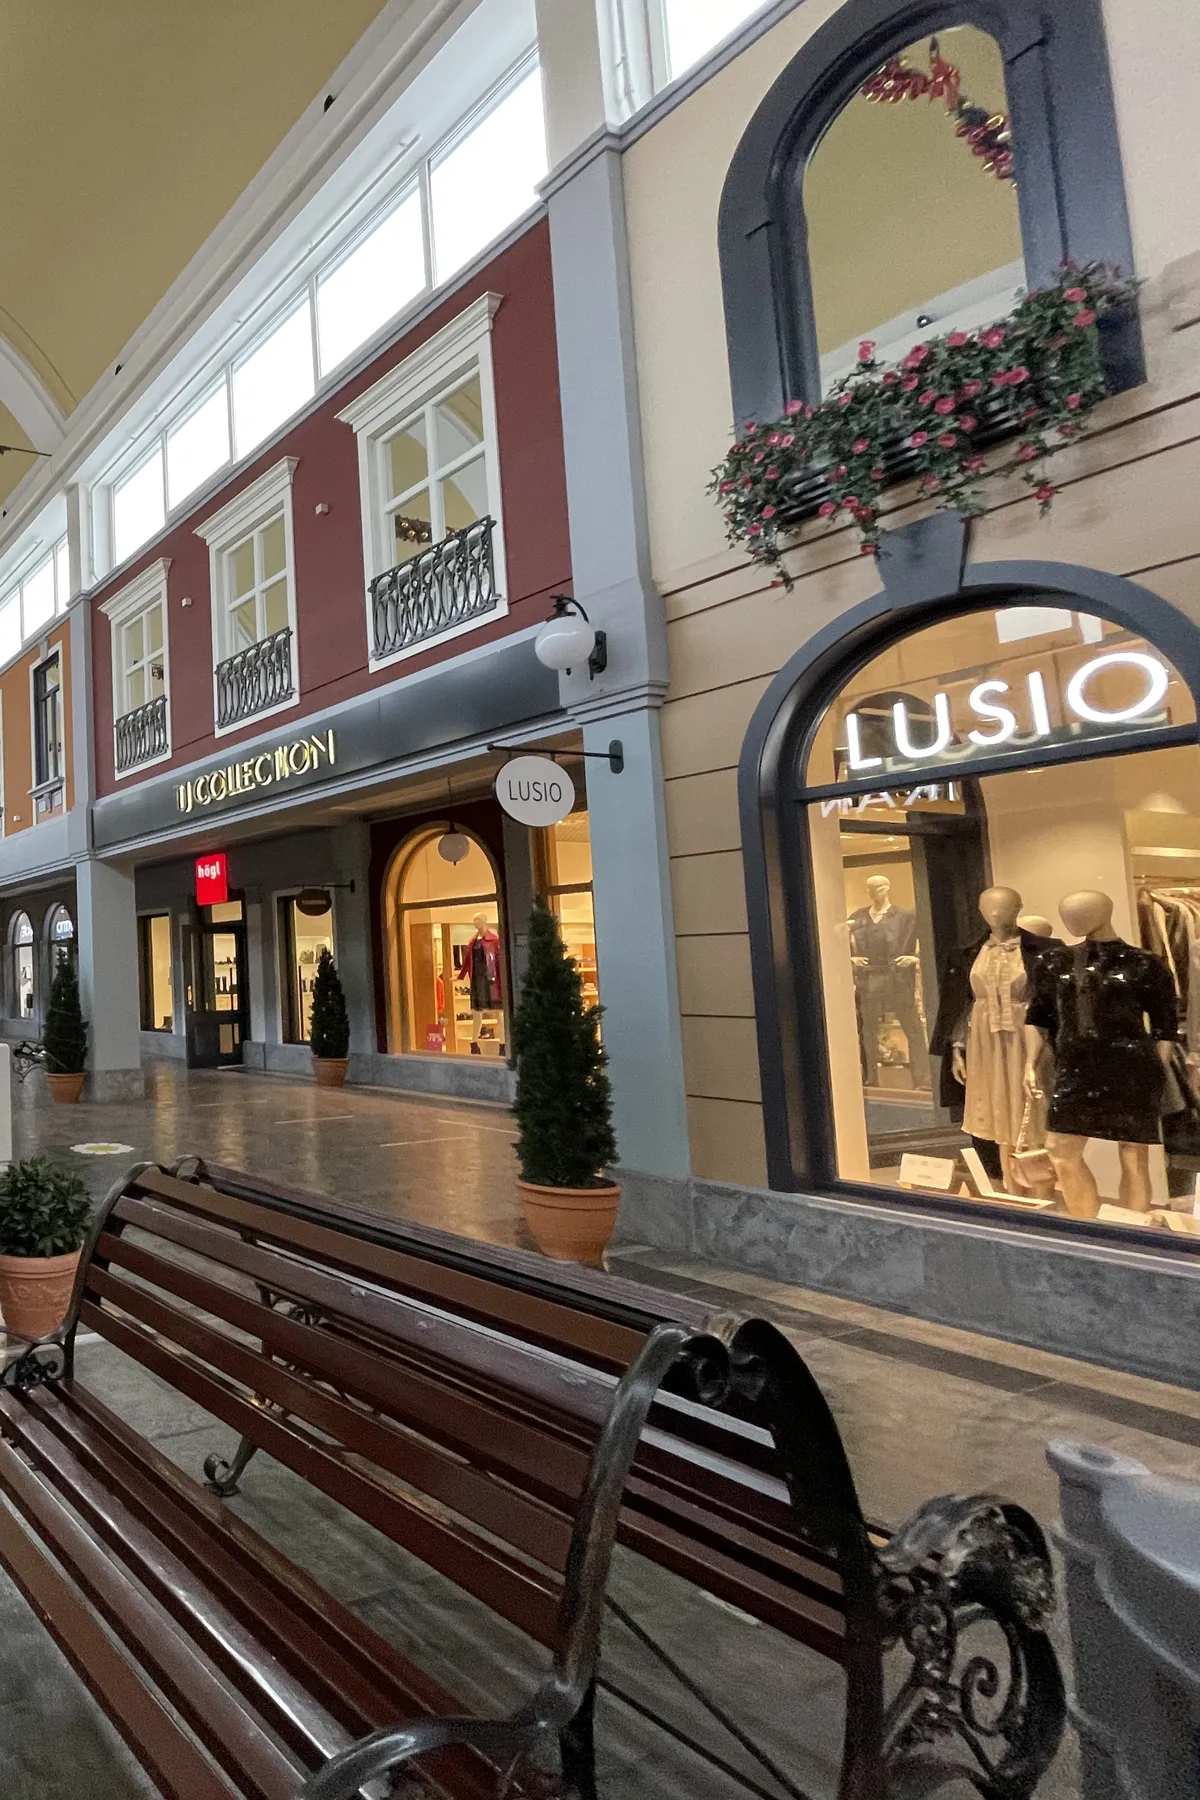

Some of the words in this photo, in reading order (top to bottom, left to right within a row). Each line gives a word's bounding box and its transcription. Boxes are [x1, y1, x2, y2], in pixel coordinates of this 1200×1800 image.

[845, 651, 1170, 770] LUSIO
[508, 779, 562, 803] LUSIO
[197, 860, 221, 880] högl
